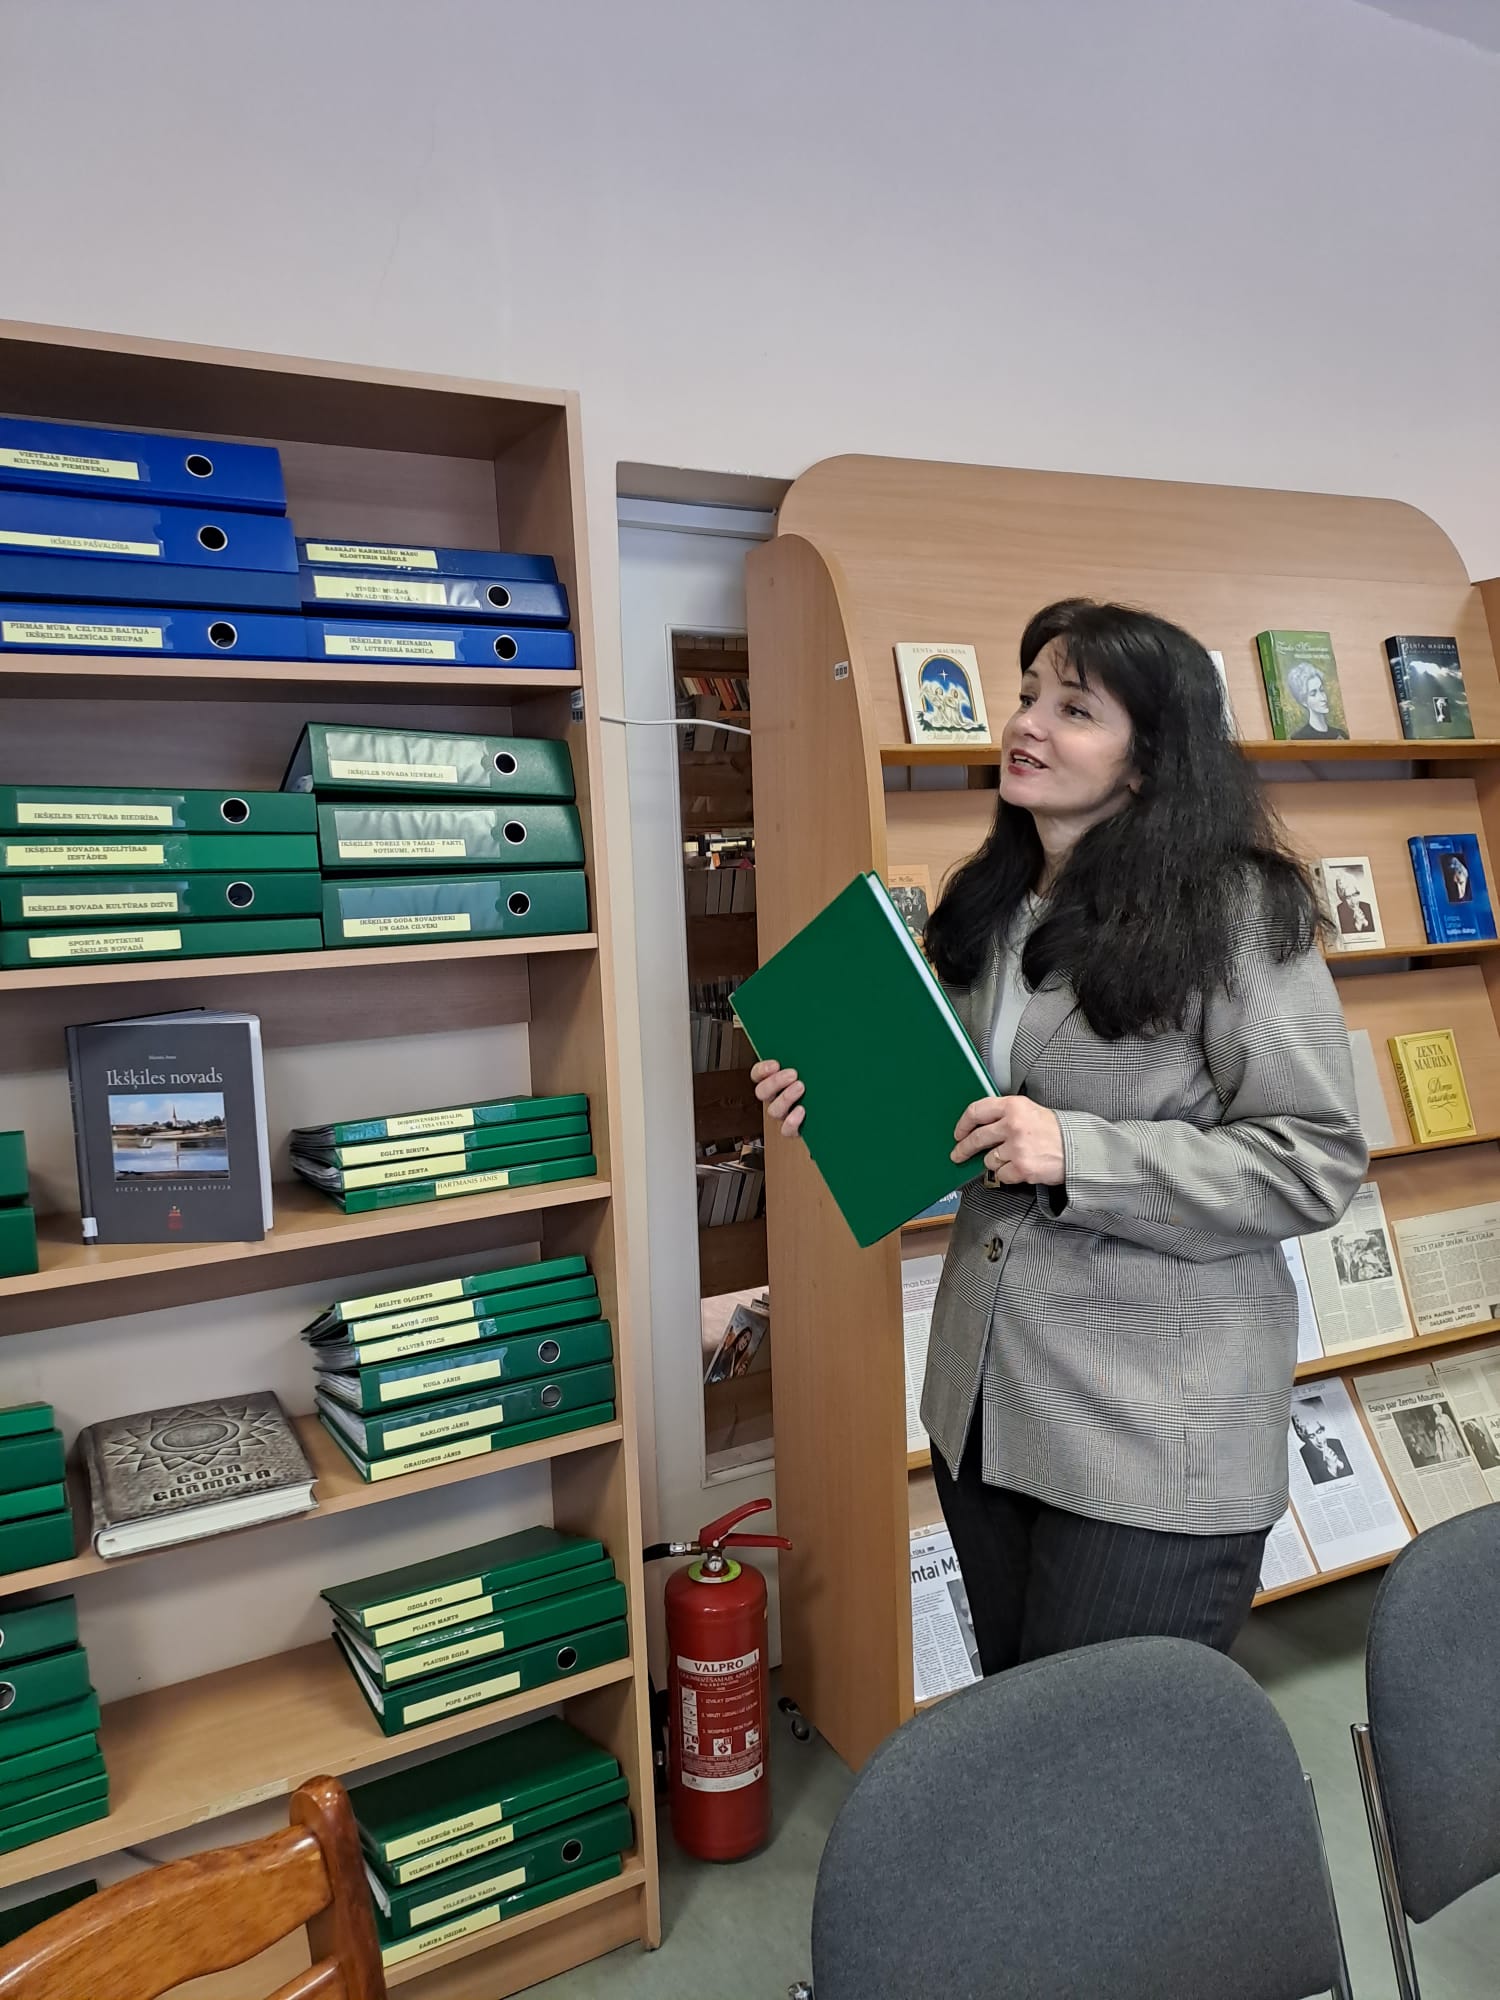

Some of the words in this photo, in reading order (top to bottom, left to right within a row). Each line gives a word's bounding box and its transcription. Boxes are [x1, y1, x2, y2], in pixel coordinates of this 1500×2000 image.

[67, 632, 108, 641] BAZNĪCAS
[381, 770, 409, 778] NOVADA
[34, 811, 73, 820] IKŠĶILES
[75, 811, 119, 820] KULTŪRAS
[120, 813, 160, 821] BIEDRĪBA
[102, 845, 147, 853] IZGLĪTĪBAS
[67, 853, 108, 861] IESTĀDES
[28, 904, 67, 912] IKŠĶILES
[69, 903, 104, 911] NOVADA
[105, 901, 148, 910] KULTŪRAS
[150, 900, 174, 908] DZĪVE
[68, 938, 101, 947] SPORTA
[103, 936, 144, 945] NOTIKUMI
[1416, 1044, 1444, 1058] ZENTA
[106, 1068, 166, 1090] Ikšķiles
[170, 1066, 224, 1084] novads
[380, 1148, 404, 1157] EGLĪTE
[405, 1146, 430, 1154] BIRUTA
[407, 1167, 429, 1176] ZENTA
[437, 1177, 478, 1190] HARTMANIS
[479, 1174, 498, 1183] JĀNIS
[420, 1315, 440, 1324] JURIS
[422, 1380, 441, 1389] KUGA
[442, 1376, 461, 1385] JĀNIS
[1368, 1403, 1386, 1413] Eseja
[1386, 1400, 1397, 1411] par
[1399, 1396, 1417, 1407] Zentu
[451, 1421, 470, 1430] JĀNIS
[403, 1455, 442, 1469] GRAUDONIS
[443, 1450, 461, 1459] JĀNIS
[176, 1463, 242, 1485] GODA
[429, 1597, 443, 1605] OTO
[694, 1659, 744, 1672] VALPRO
[487, 1835, 507, 1847] ZENTA
